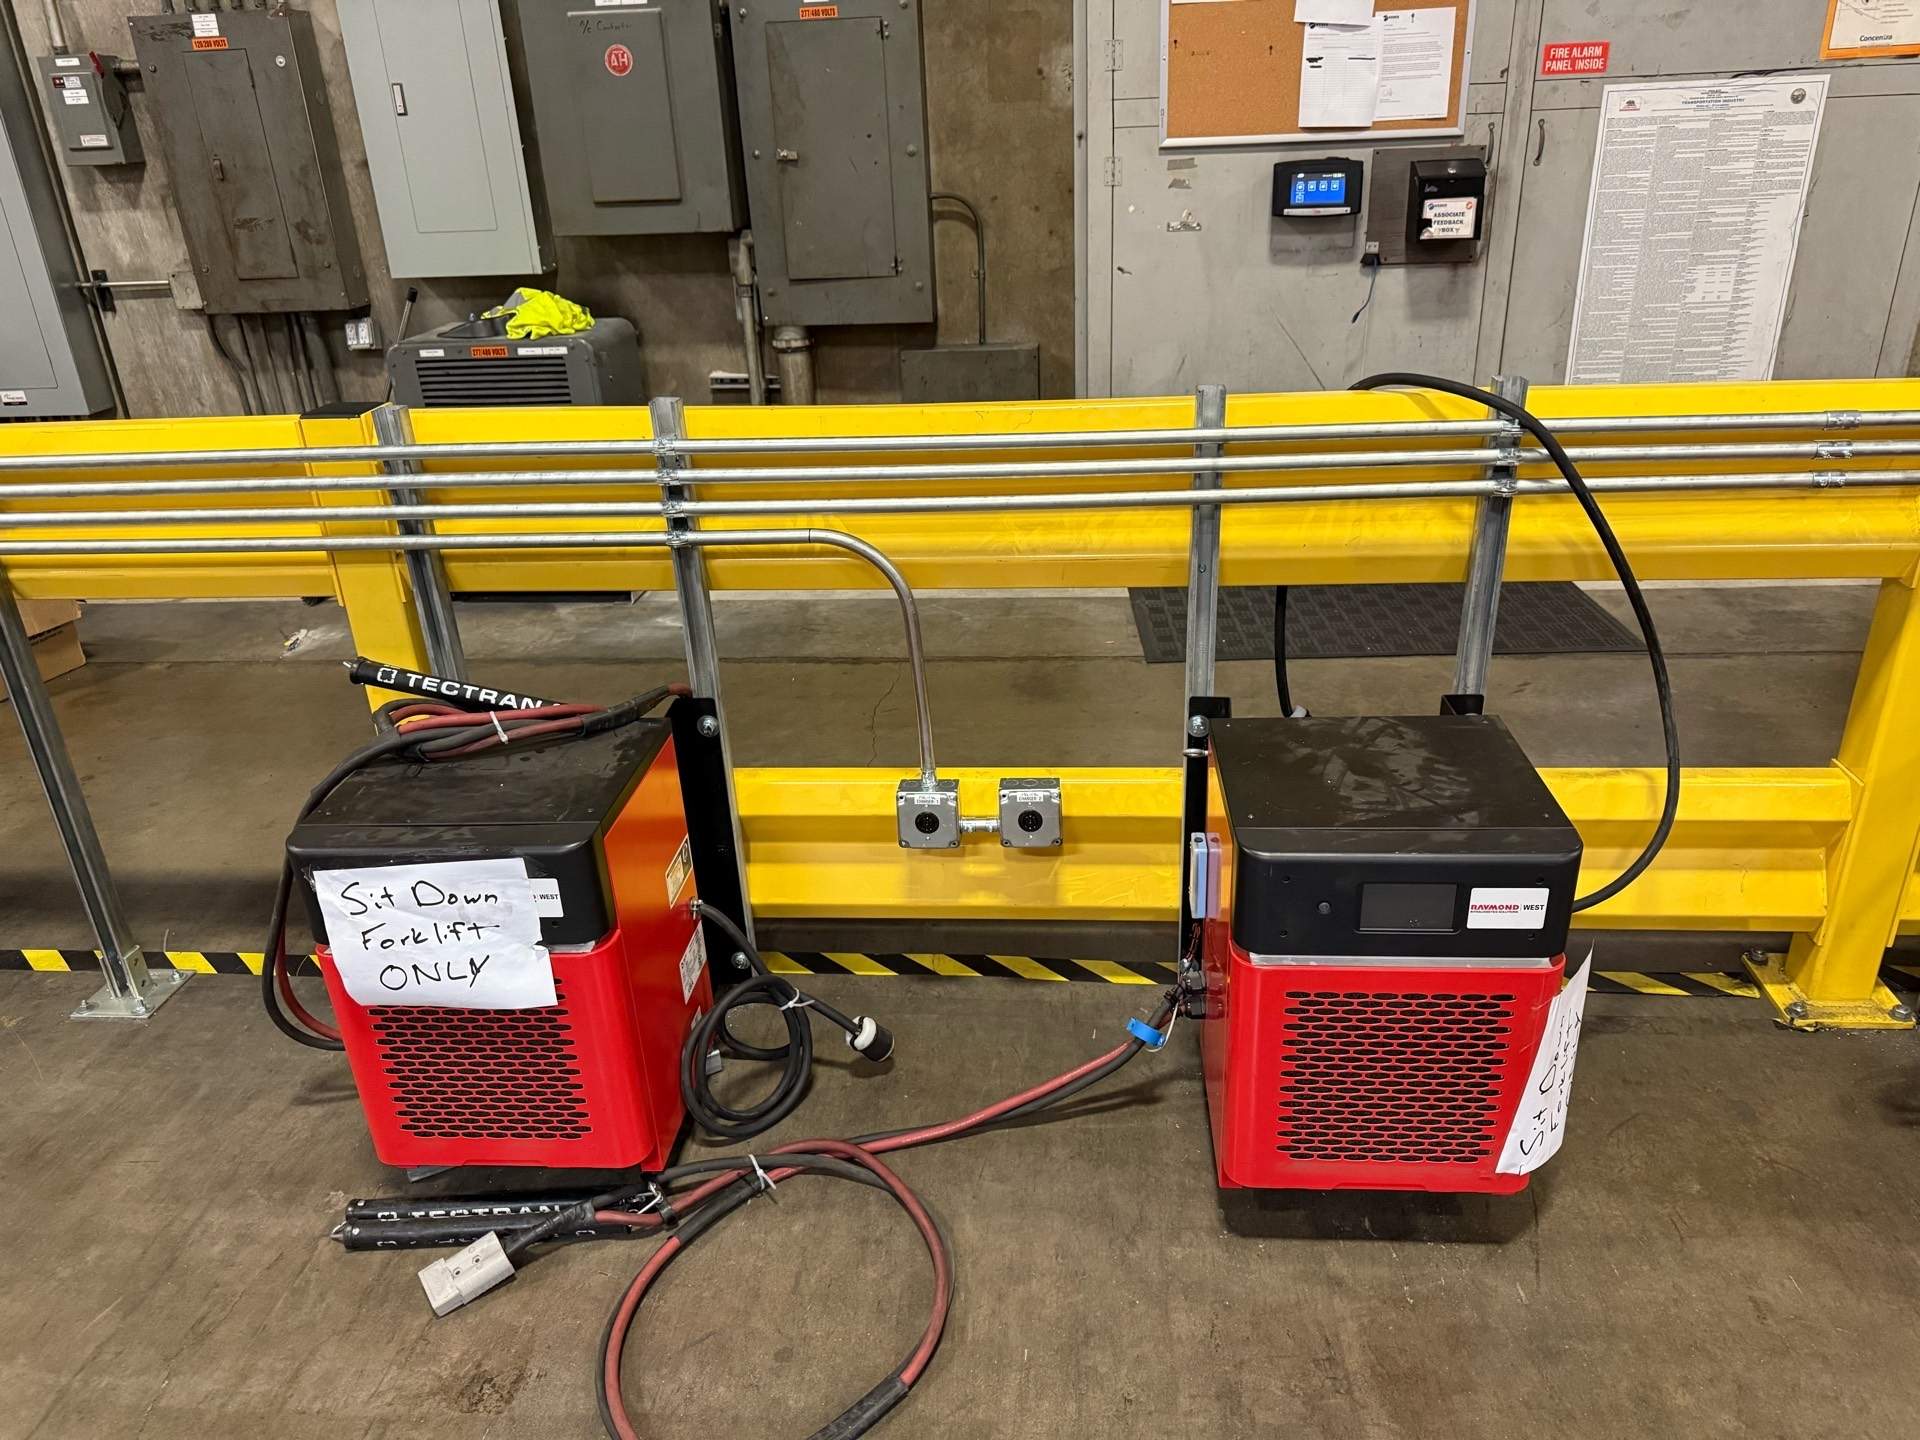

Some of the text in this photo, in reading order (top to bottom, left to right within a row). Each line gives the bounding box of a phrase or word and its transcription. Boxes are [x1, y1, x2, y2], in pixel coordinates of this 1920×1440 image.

[821, 7, 836, 17] VOLTS
[1545, 58, 1604, 71] PANEL INSIDE
[1550, 45, 1603, 59] FIRE ALARM
[406, 672, 543, 710] TECTRAN
[340, 880, 499, 916] Sit Down
[361, 922, 500, 950] Forklift
[379, 954, 490, 990] ONLY
